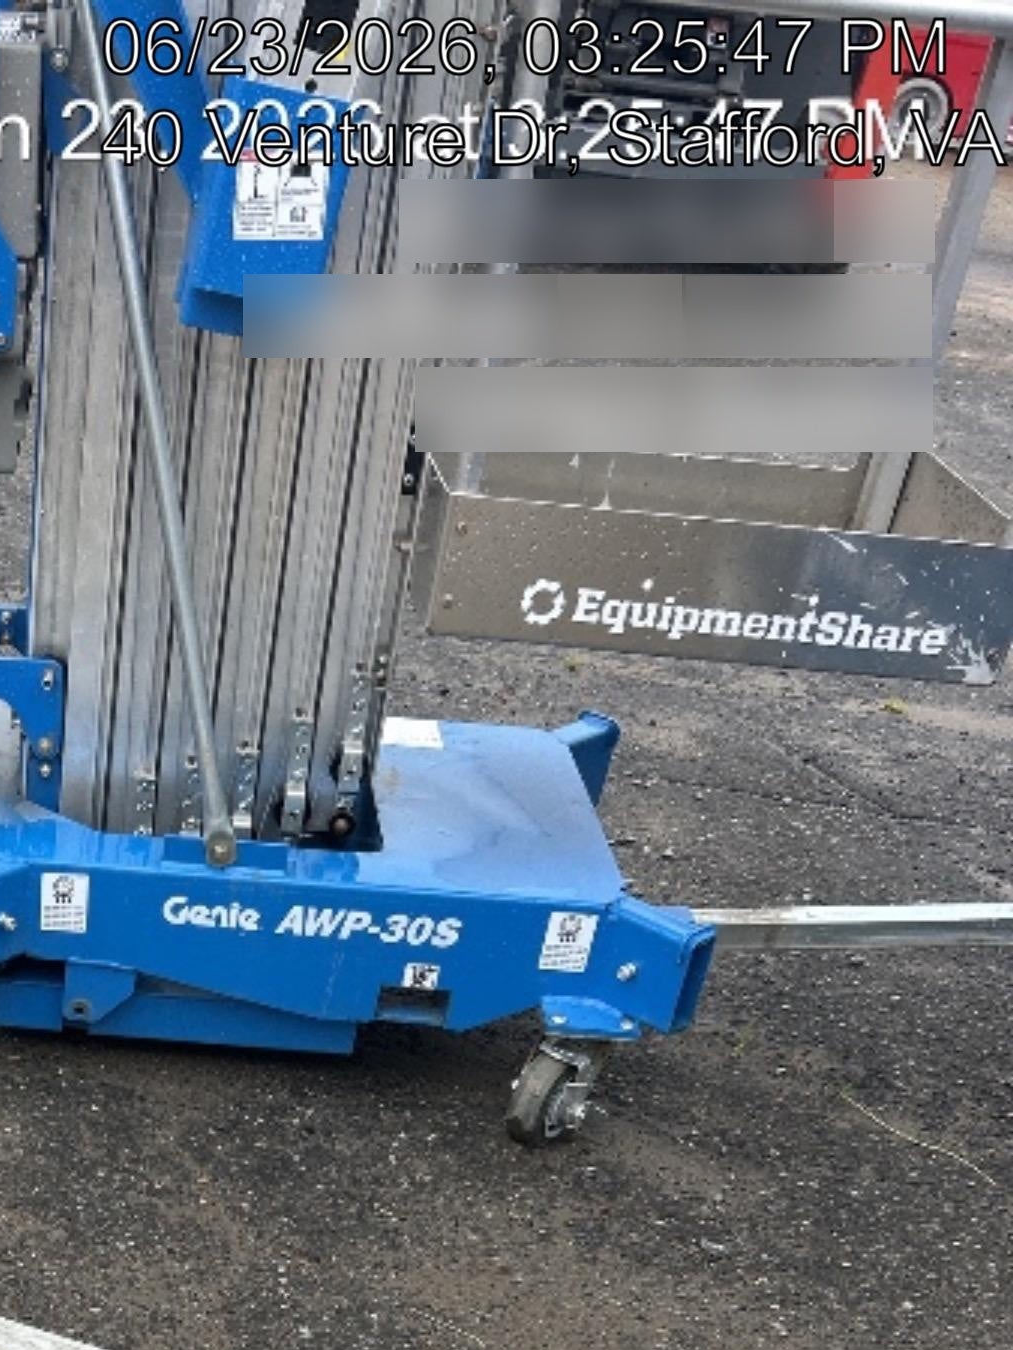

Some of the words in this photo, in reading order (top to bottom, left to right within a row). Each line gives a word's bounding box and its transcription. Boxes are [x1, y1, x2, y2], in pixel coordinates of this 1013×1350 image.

[572, 586, 948, 655] EquipmentShare
[163, 896, 261, 933] Genie
[275, 905, 463, 949] AWP-30S
